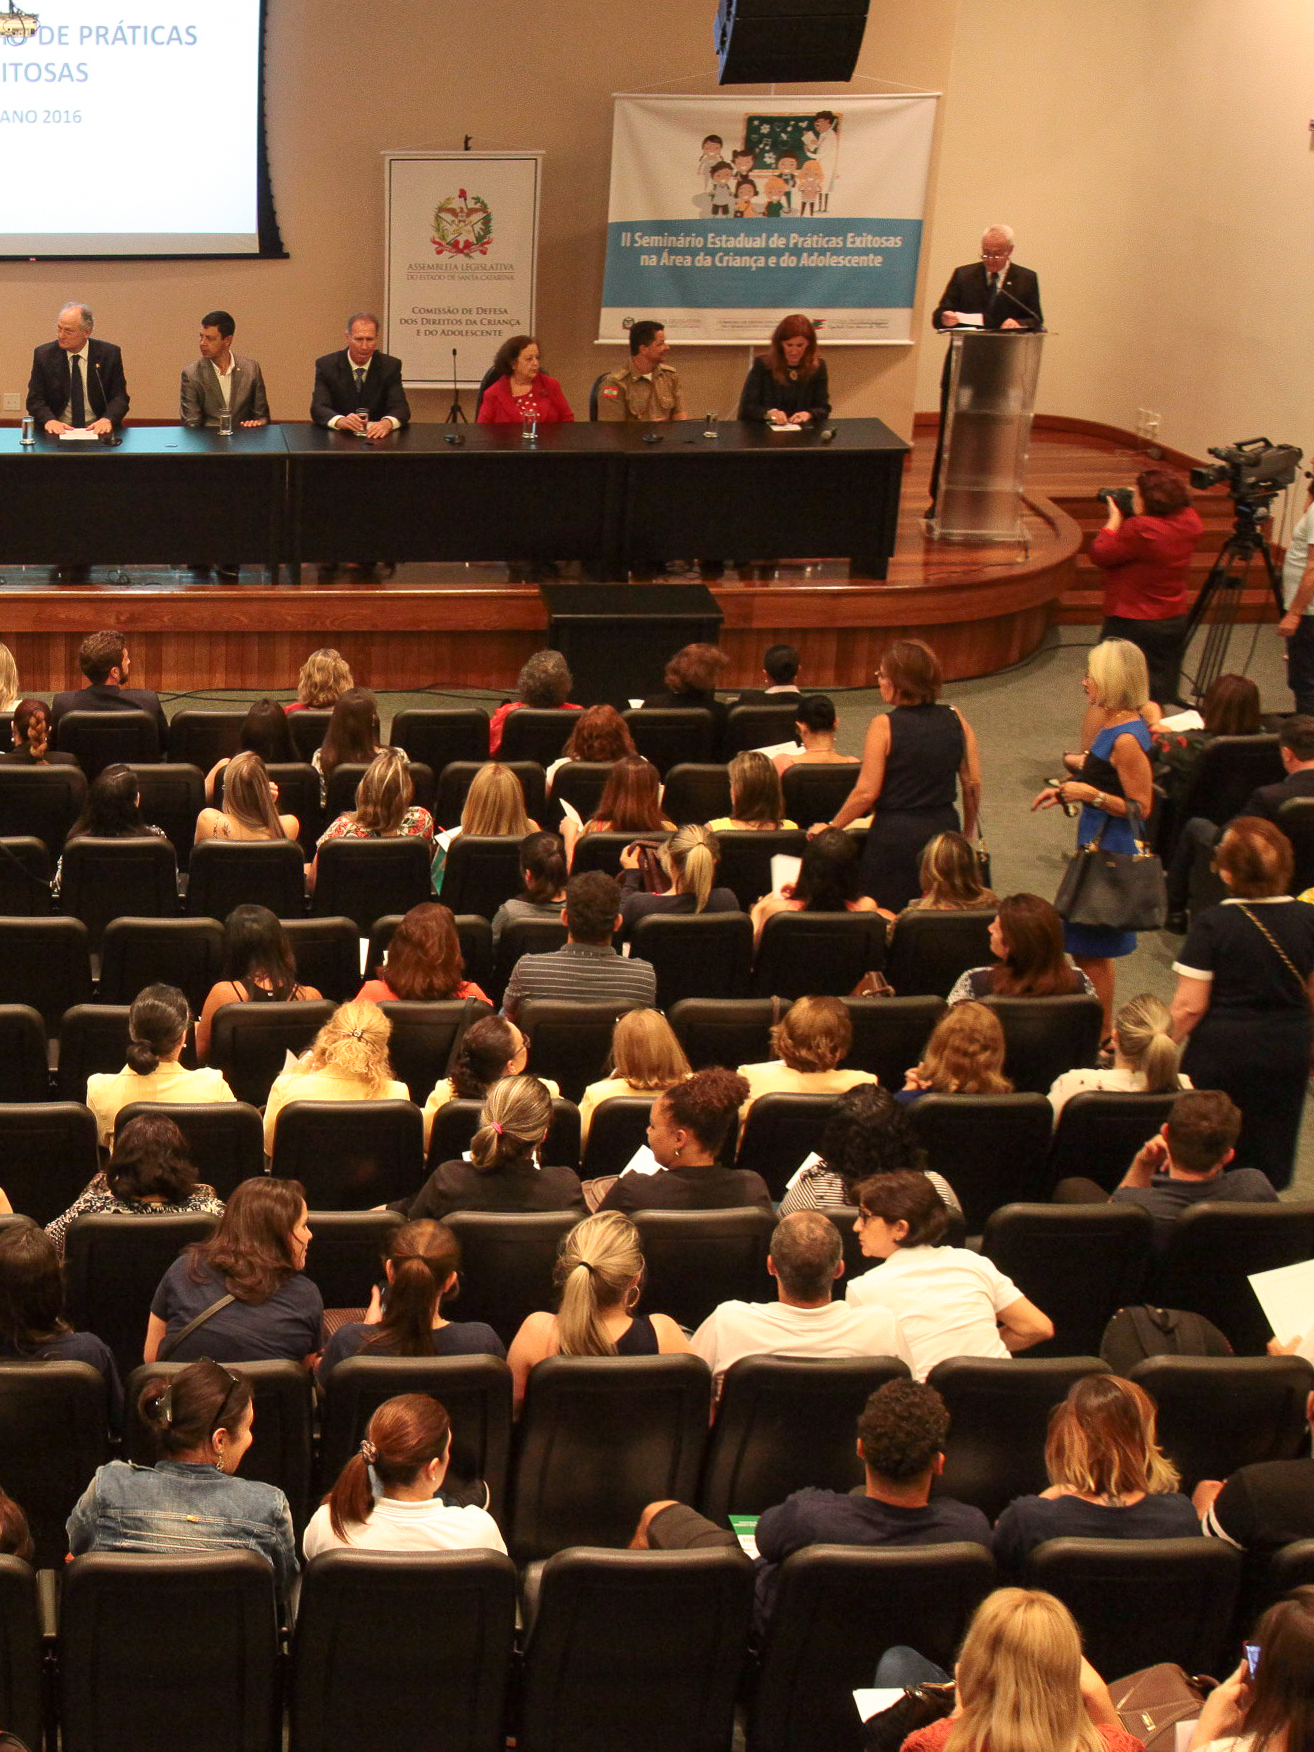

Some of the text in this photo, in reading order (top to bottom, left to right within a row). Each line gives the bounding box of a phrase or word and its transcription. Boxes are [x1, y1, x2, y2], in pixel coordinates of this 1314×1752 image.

[38, 25, 70, 46] DE
[79, 19, 198, 46] PRÁTICAS
[0, 109, 82, 124] ANO 2016
[620, 232, 903, 248] II Seminário Estadual de Práticas Exitosas
[640, 249, 883, 270] na Área da Criança e do Adolescente
[407, 262, 514, 271] ASSEMBLEIA LEGISLATIVA
[411, 306, 509, 315] COMISSÃO DE DEFESA
[399, 317, 521, 327] DOS DIREITOS DA CRIANÇA
[416, 329, 503, 337] E DO ADOLESCENTE
